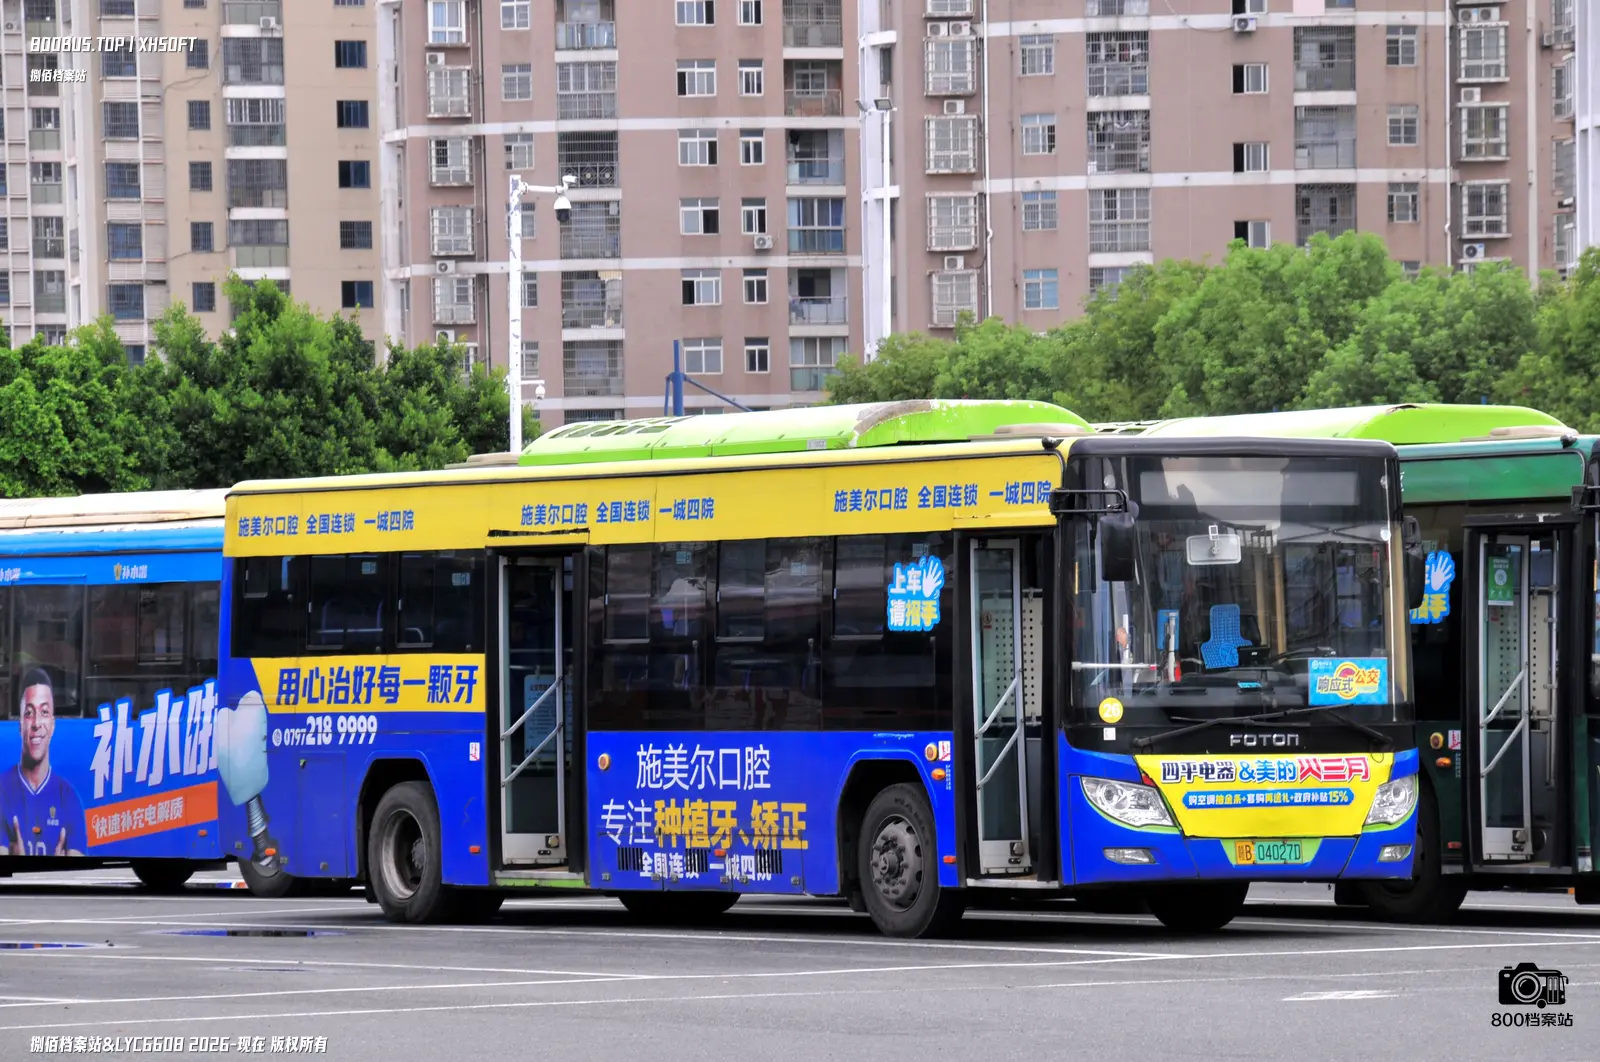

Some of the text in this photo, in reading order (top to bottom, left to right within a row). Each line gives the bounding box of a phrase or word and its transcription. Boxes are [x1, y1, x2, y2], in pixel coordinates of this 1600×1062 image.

[833, 480, 1051, 512] 施美尔口腔 全国连锁 一城四院
[238, 510, 414, 537] 施美尔口腔 全国连锁 一城四院
[520, 497, 714, 526] 施美尔口腔 全国连锁 一城四院
[890, 567, 922, 595] 上车
[889, 599, 938, 627] 请招手
[276, 665, 479, 705] 用心治好每一颗牙
[1317, 676, 1354, 692] 响应式
[1355, 669, 1379, 684] 公交
[1103, 703, 1121, 718] 26
[337, 714, 378, 745] 9999
[1230, 734, 1299, 747] FOTON
[636, 743, 771, 790] 施美尔口腔
[601, 798, 808, 849] 专注种植牙、矫正
